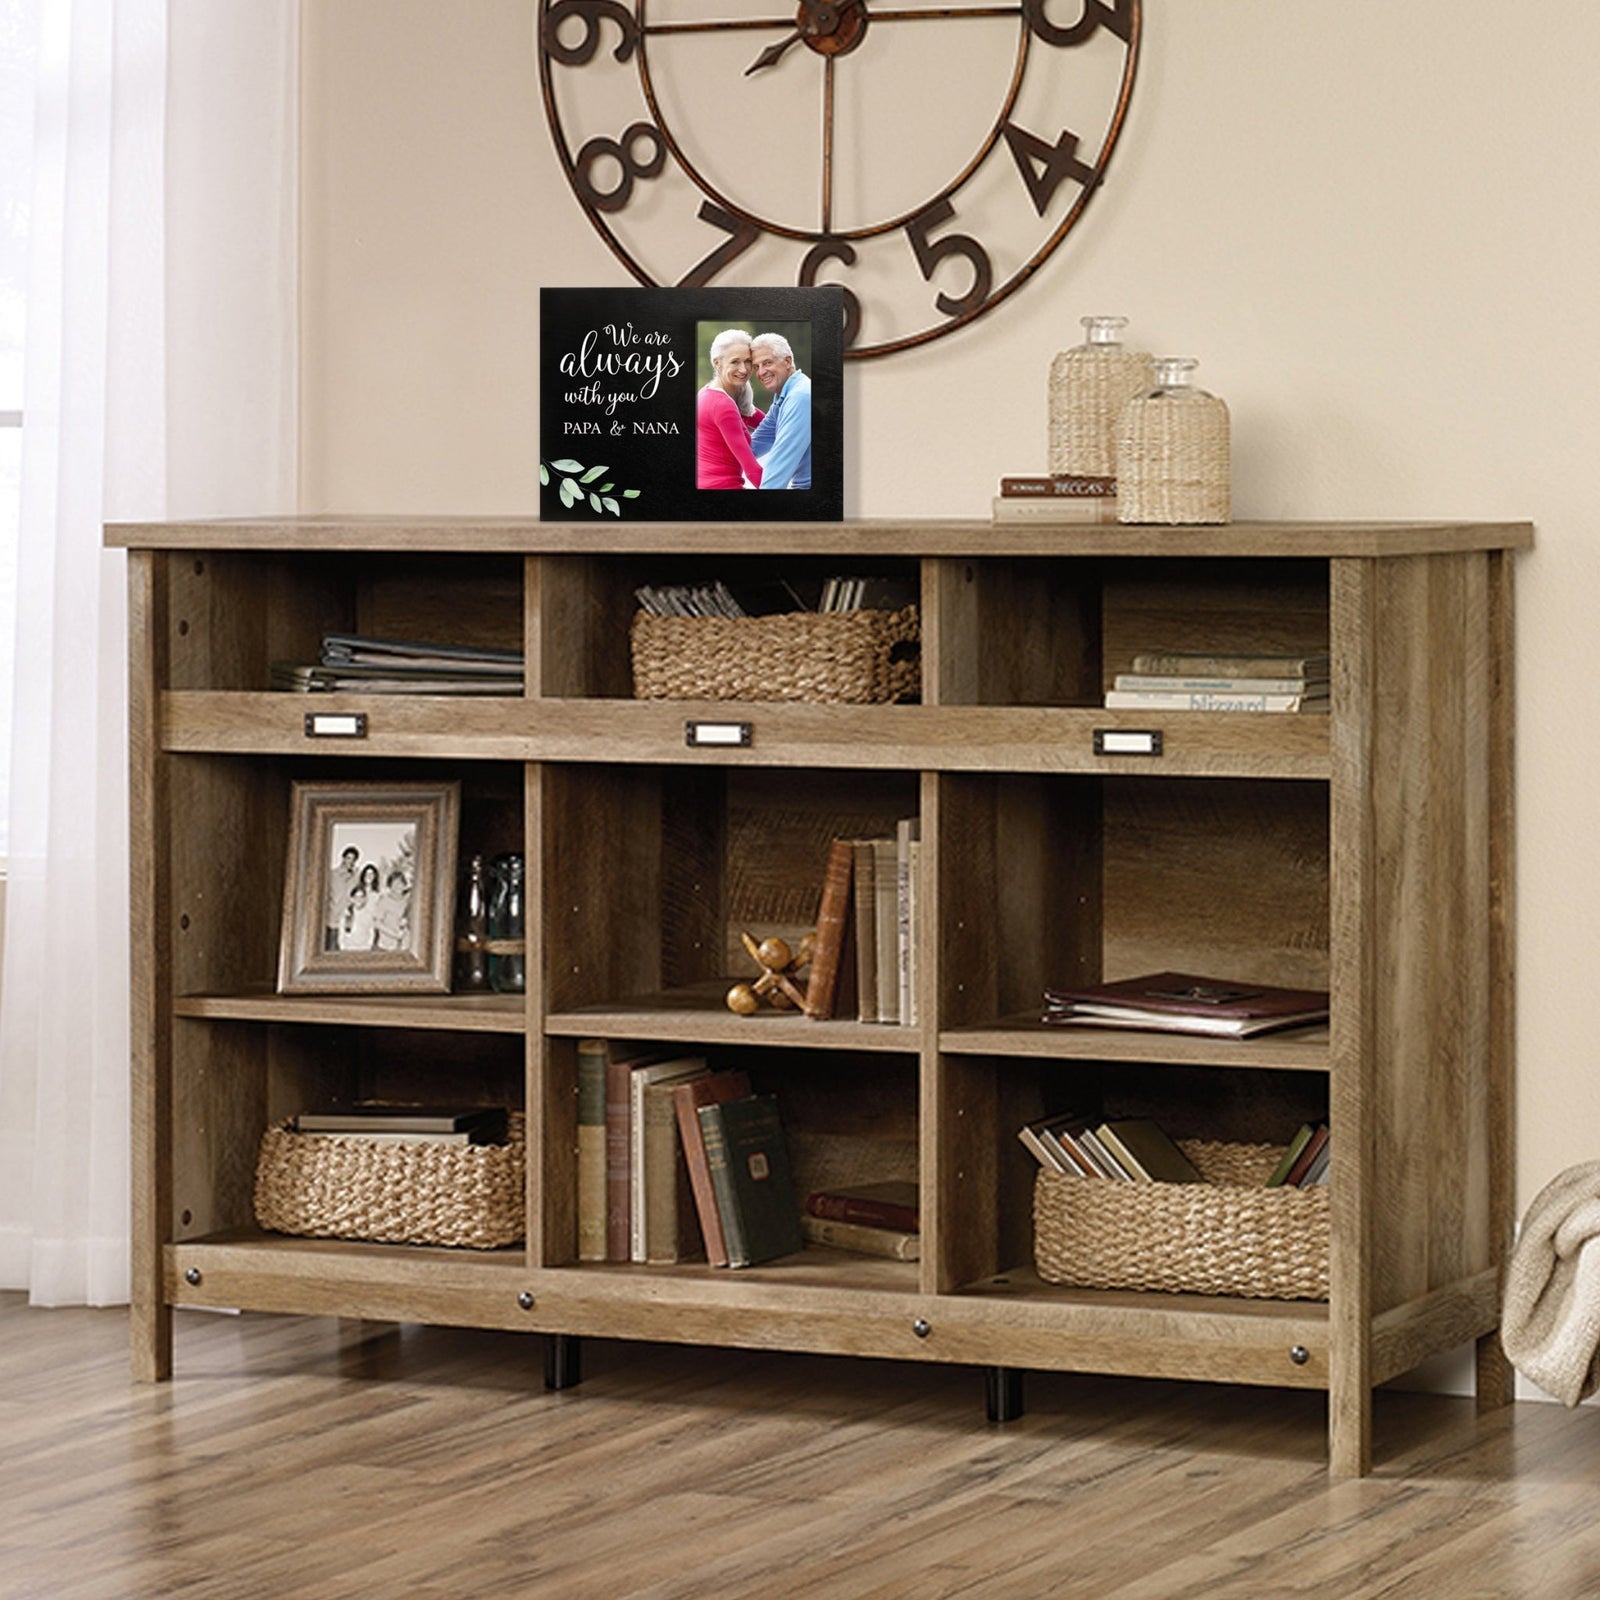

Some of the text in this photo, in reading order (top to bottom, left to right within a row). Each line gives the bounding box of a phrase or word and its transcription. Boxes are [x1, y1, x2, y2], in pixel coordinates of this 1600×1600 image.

[576, 121, 668, 213] 8
[1003, 120, 1104, 217] 4
[676, 199, 760, 287] 7
[902, 199, 993, 317] 5
[559, 329, 685, 400] always
[602, 321, 672, 348] We are
[563, 380, 638, 416] with you
[563, 419, 680, 437] PAPA & NANA
